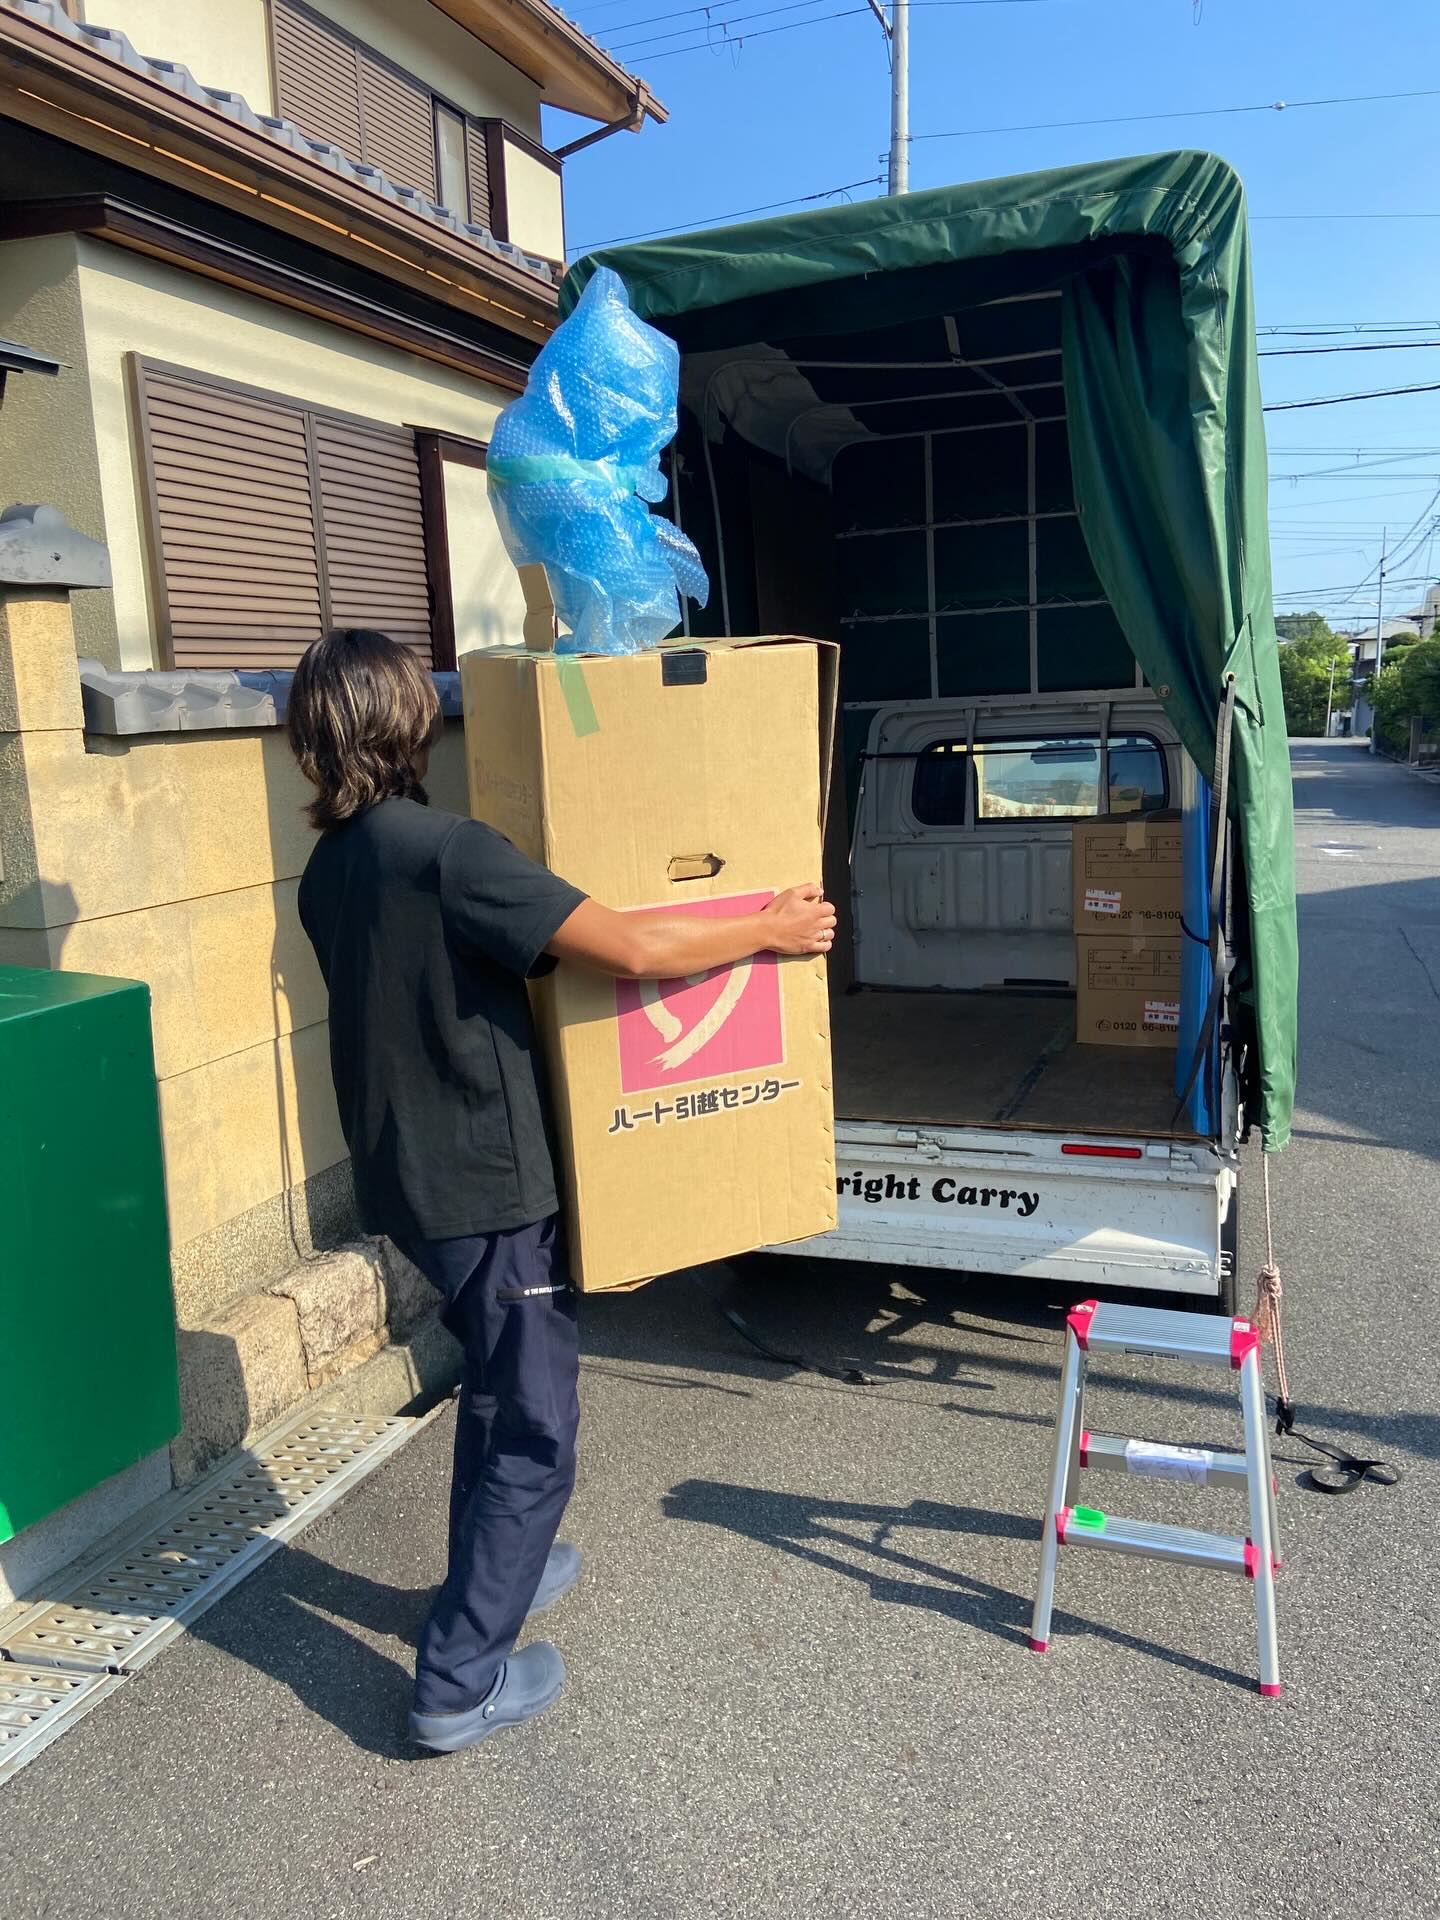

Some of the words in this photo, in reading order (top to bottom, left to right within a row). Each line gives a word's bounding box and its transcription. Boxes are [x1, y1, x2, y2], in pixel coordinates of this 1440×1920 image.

[1113, 1022, 1137, 1031] 0120
[608, 1079, 800, 1133] ハート引越センター
[932, 1178, 1040, 1217] Carry
